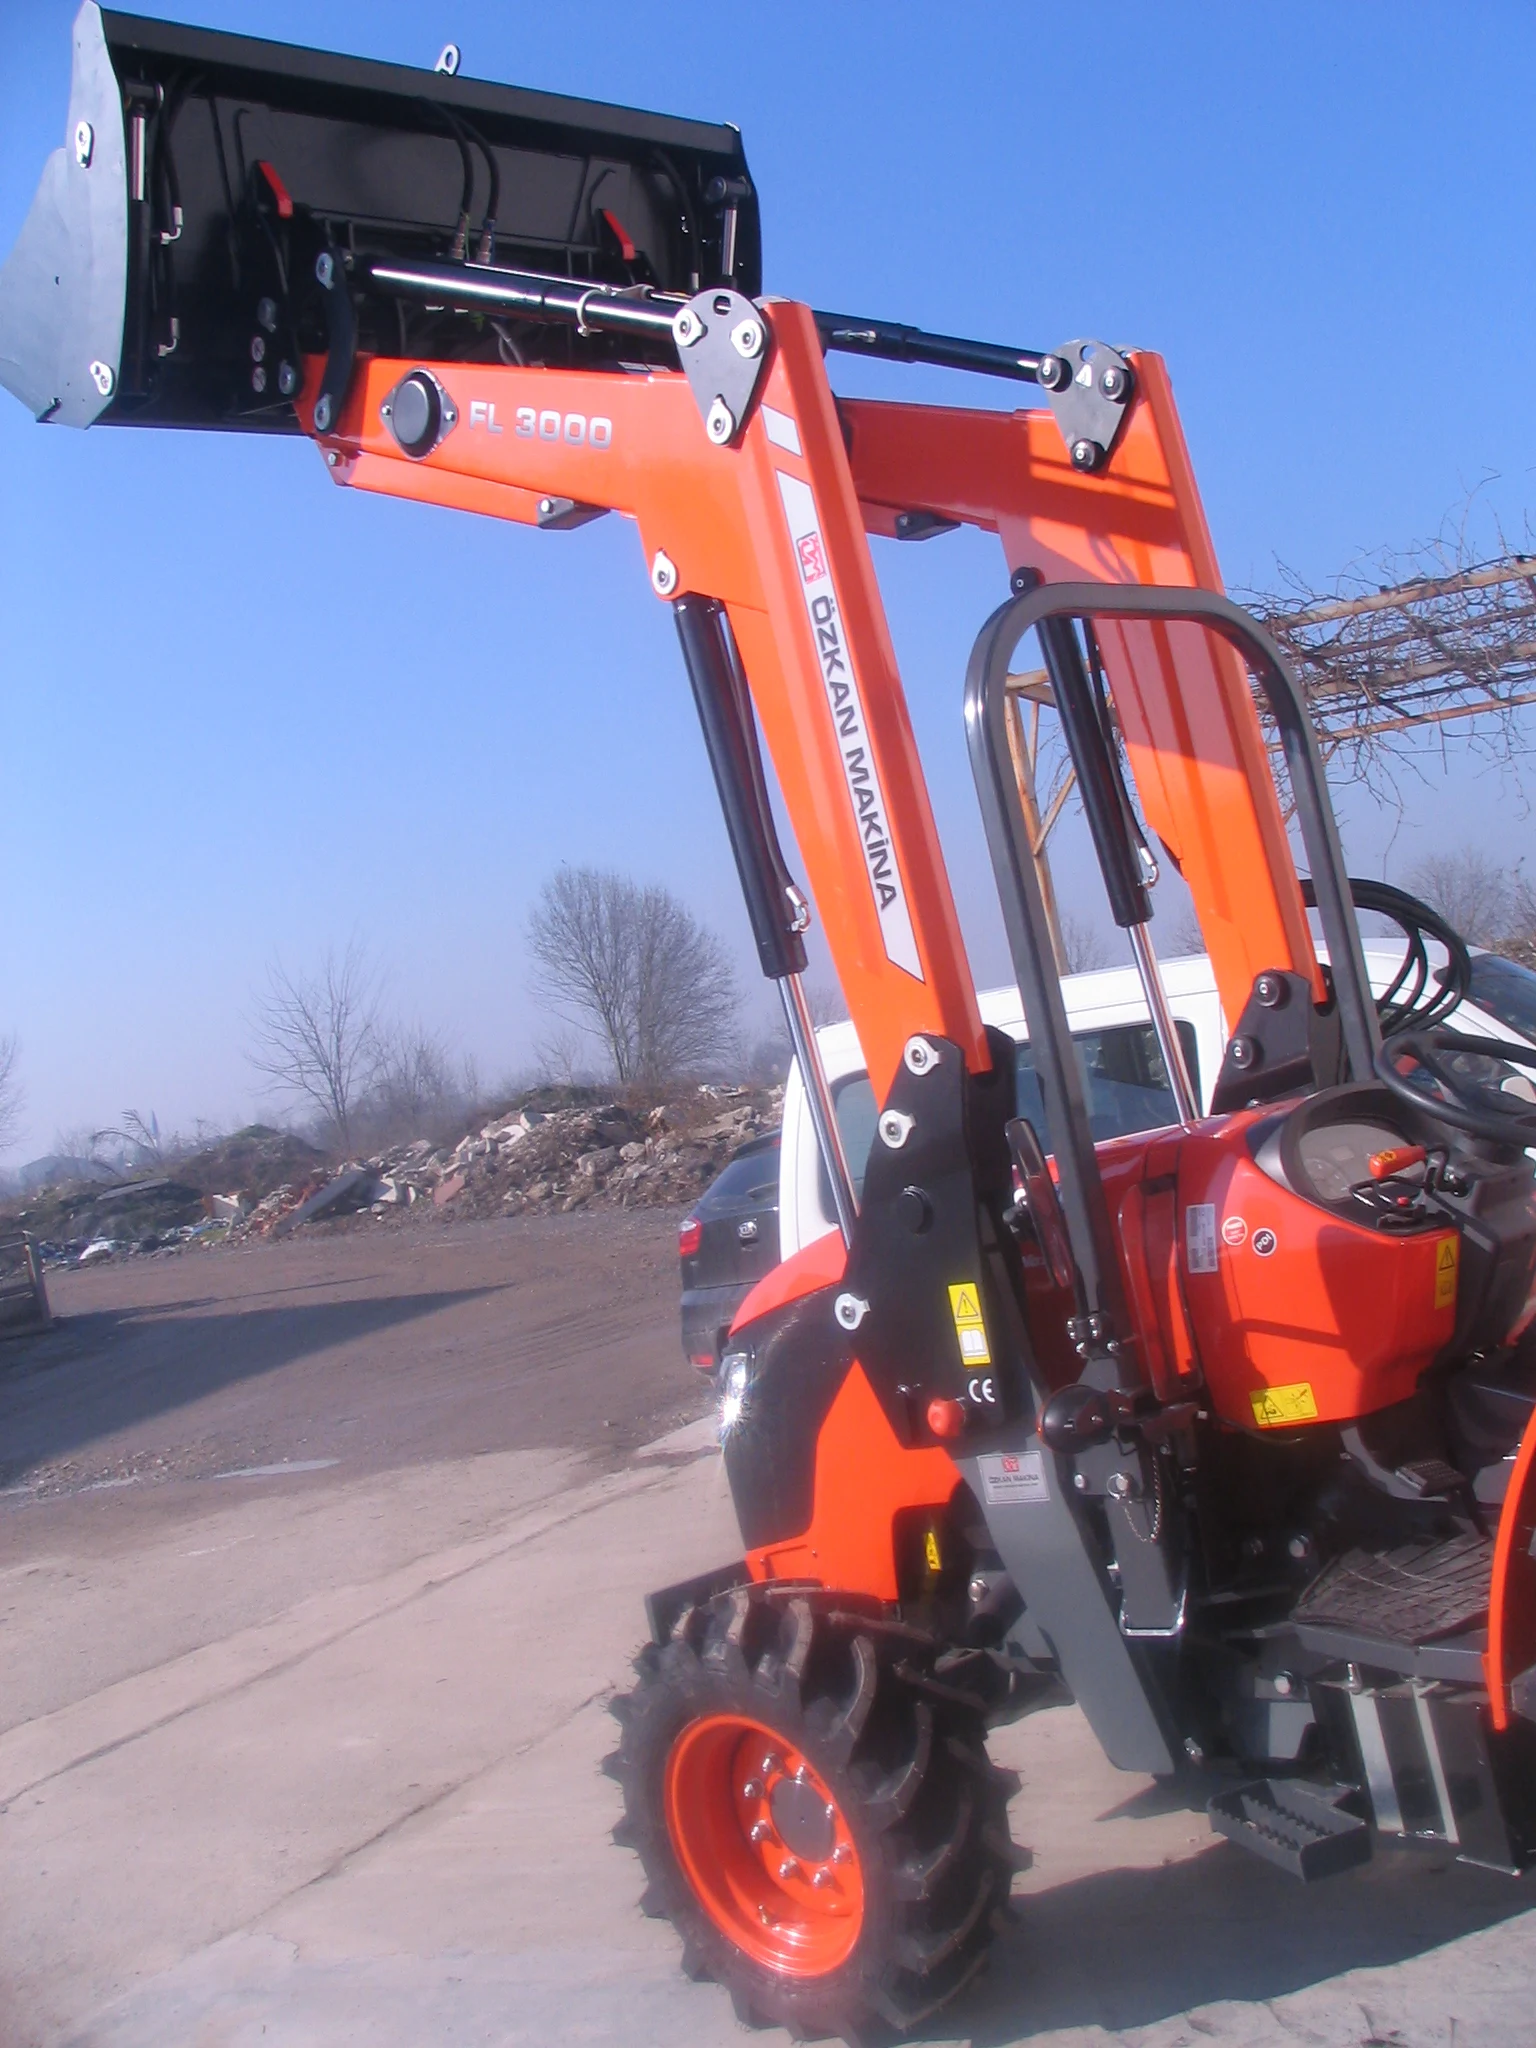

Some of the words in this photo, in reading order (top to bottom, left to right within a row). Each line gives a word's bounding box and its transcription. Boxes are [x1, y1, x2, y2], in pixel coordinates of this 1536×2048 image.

[469, 401, 503, 434] FL
[515, 406, 613, 450] 3000
[810, 596, 859, 739] ÖZKAN
[845, 748, 898, 910] MAKİNA
[968, 1378, 996, 1404] CE
